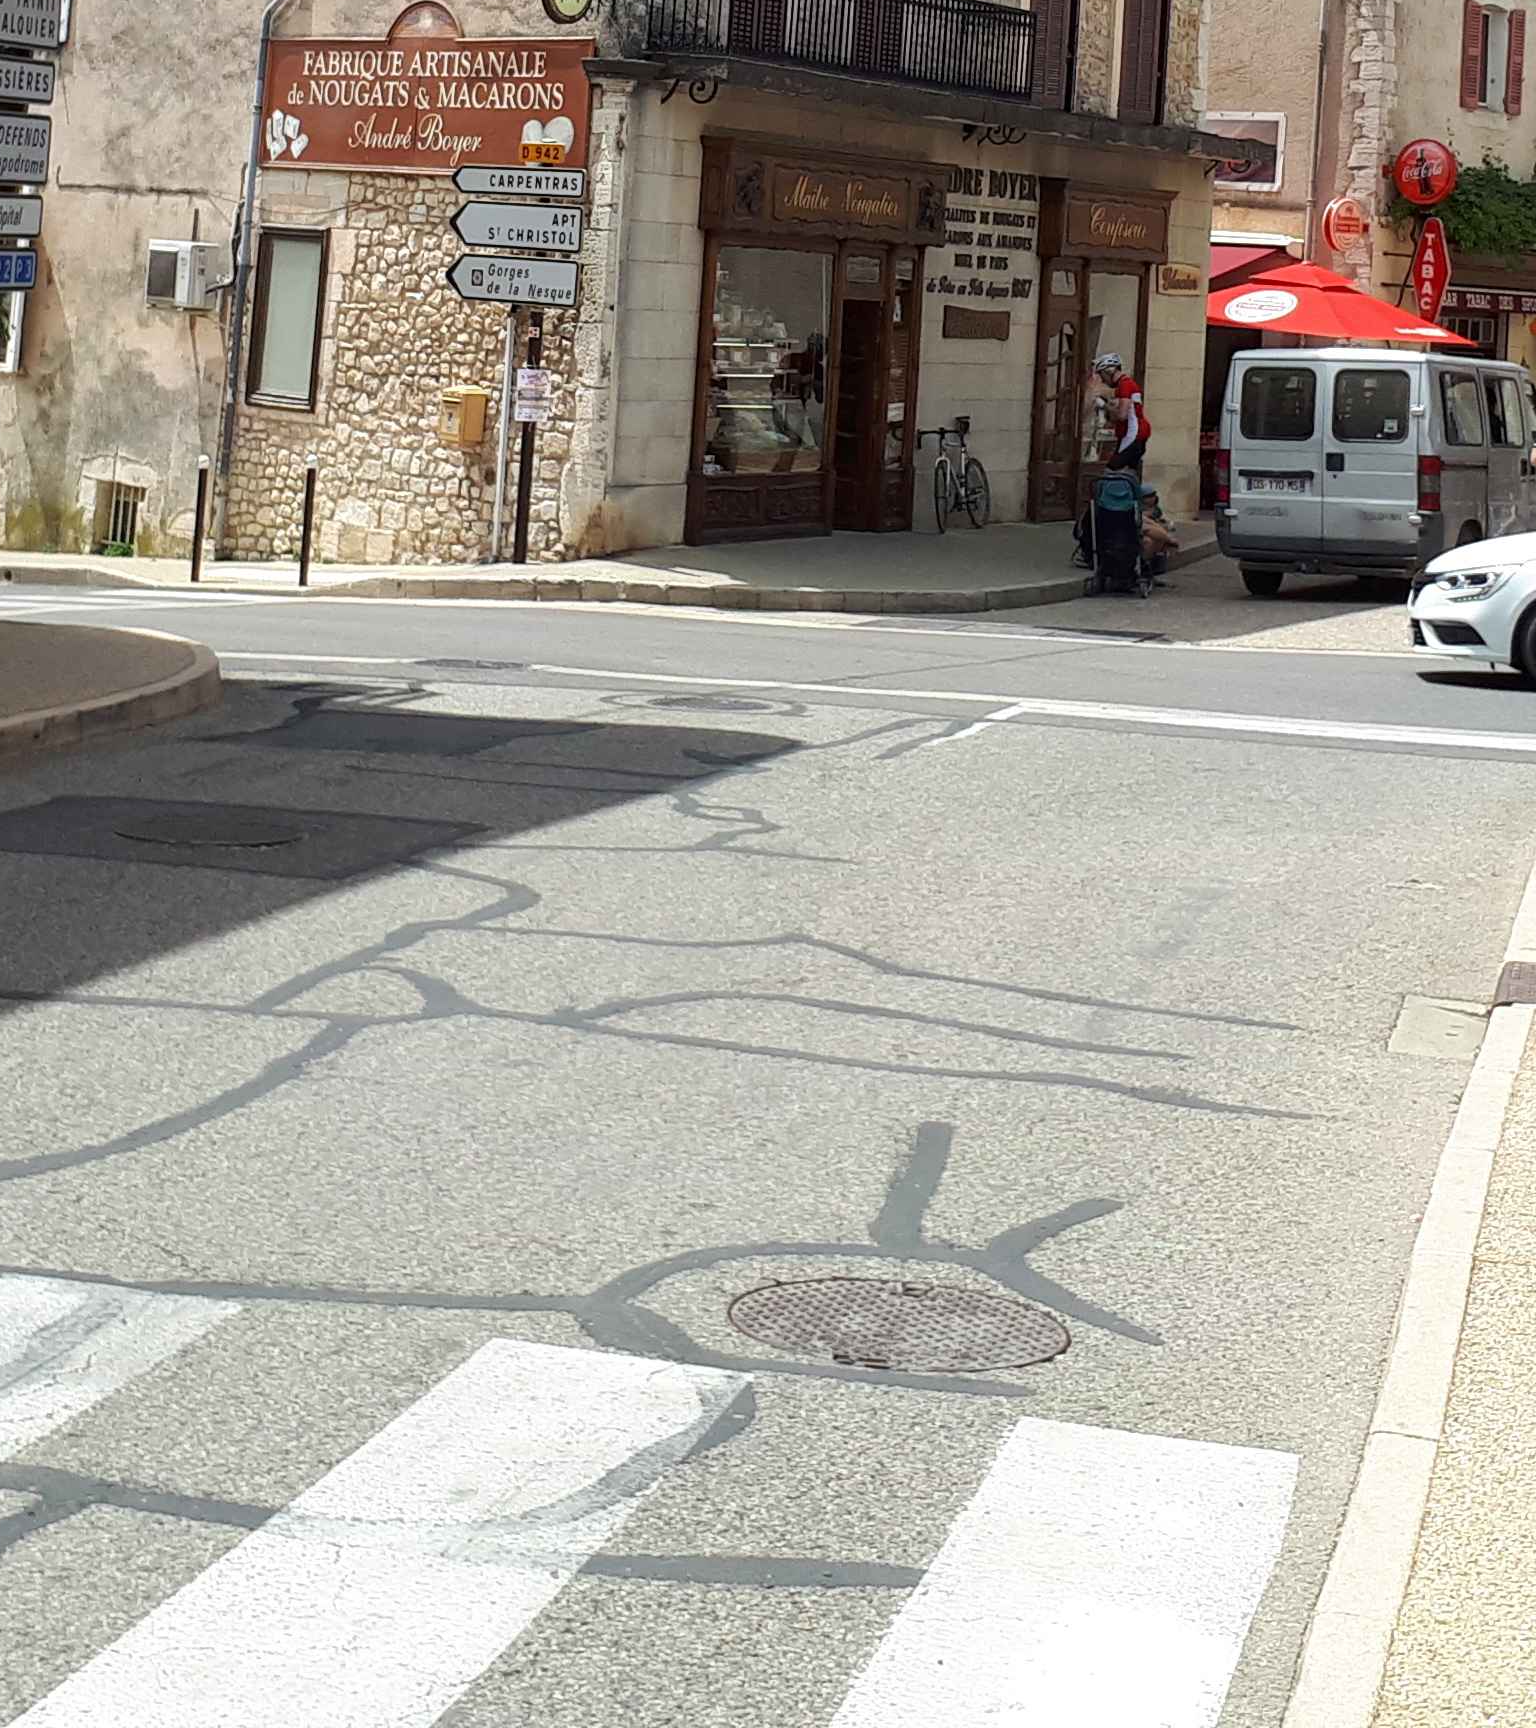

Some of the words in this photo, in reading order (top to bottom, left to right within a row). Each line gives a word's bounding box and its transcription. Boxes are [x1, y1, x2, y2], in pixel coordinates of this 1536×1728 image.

[302, 50, 405, 82] FABRIQUE
[409, 50, 547, 80] ARTISANALE
[287, 85, 305, 106] de
[307, 79, 410, 108] NOUGATS
[414, 87, 431, 110] &
[436, 82, 564, 112] MACARONS
[347, 112, 413, 150] André
[416, 112, 483, 167] Boyer
[521, 146, 530, 161] D
[534, 147, 560, 161] 942
[489, 174, 579, 192] CARPENTRAS
[948, 167, 984, 197] DRE
[987, 169, 1038, 202] BOYER
[551, 213, 577, 229] APT
[507, 228, 575, 246] CHRISTOL
[487, 264, 531, 281] Gorges
[1419, 232, 1438, 311] TABAC
[486, 280, 502, 296] de
[508, 281, 520, 297] la
[527, 283, 573, 302] Nesque
